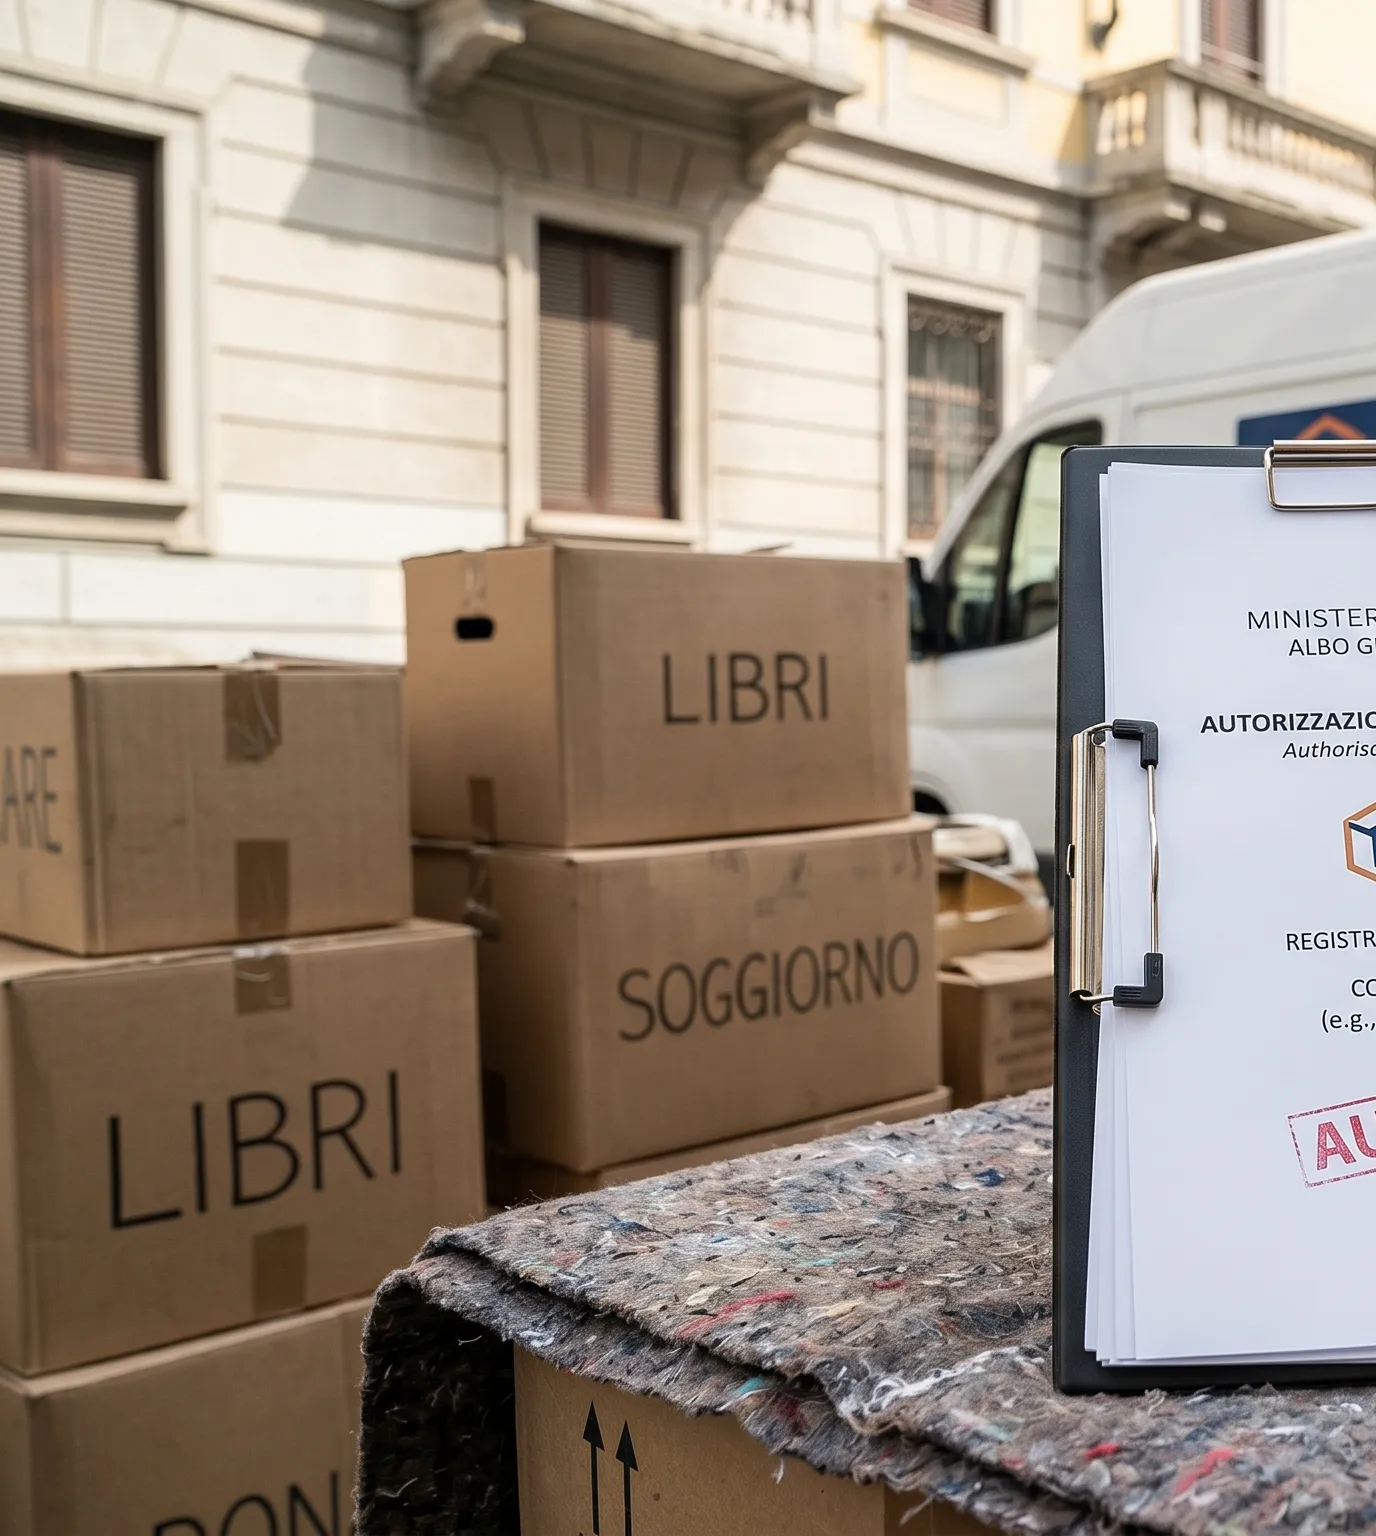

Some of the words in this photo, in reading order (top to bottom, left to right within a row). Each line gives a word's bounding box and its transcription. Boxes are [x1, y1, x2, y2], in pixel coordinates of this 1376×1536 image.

[662, 652, 829, 724] LIBRI
[1288, 636, 1350, 657] ALBO
[617, 930, 919, 1042] SOGGIORNO
[107, 1070, 402, 1229] LIBRI
